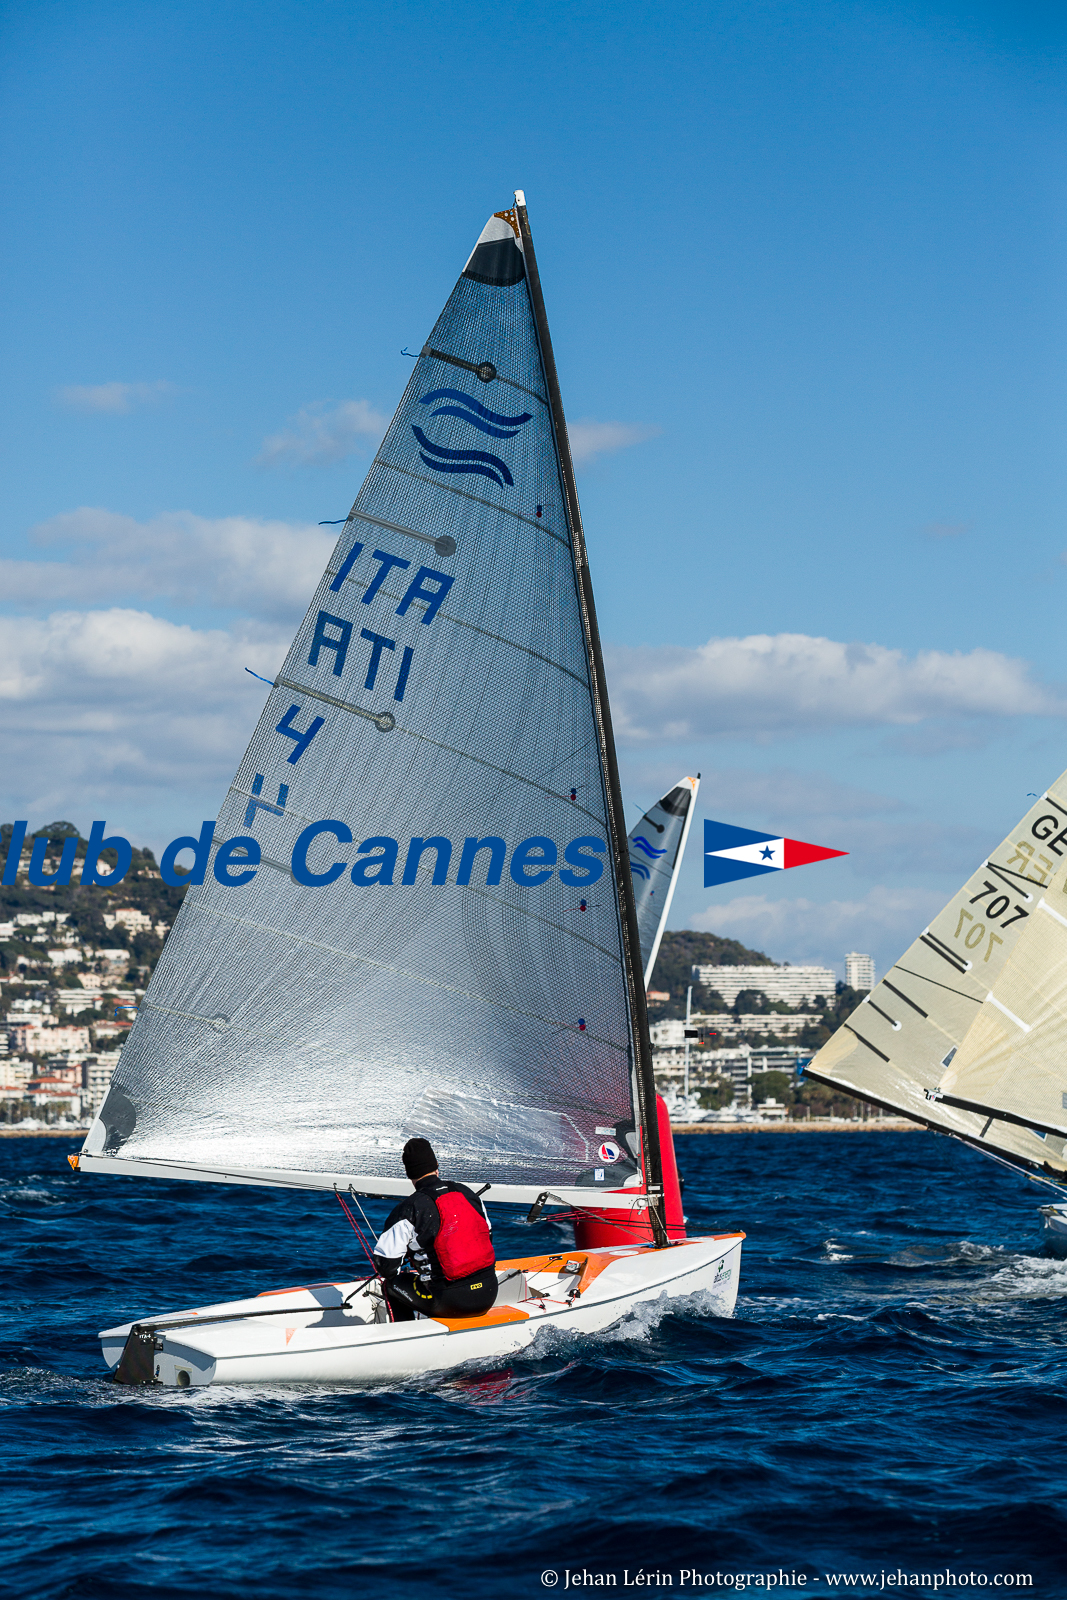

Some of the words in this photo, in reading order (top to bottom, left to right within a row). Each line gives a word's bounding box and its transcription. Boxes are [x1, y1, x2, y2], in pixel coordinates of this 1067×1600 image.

[329, 542, 455, 625] ITA
[275, 704, 325, 765] 4
[1031, 815, 1067, 857] GE
[969, 880, 1029, 929] 707
